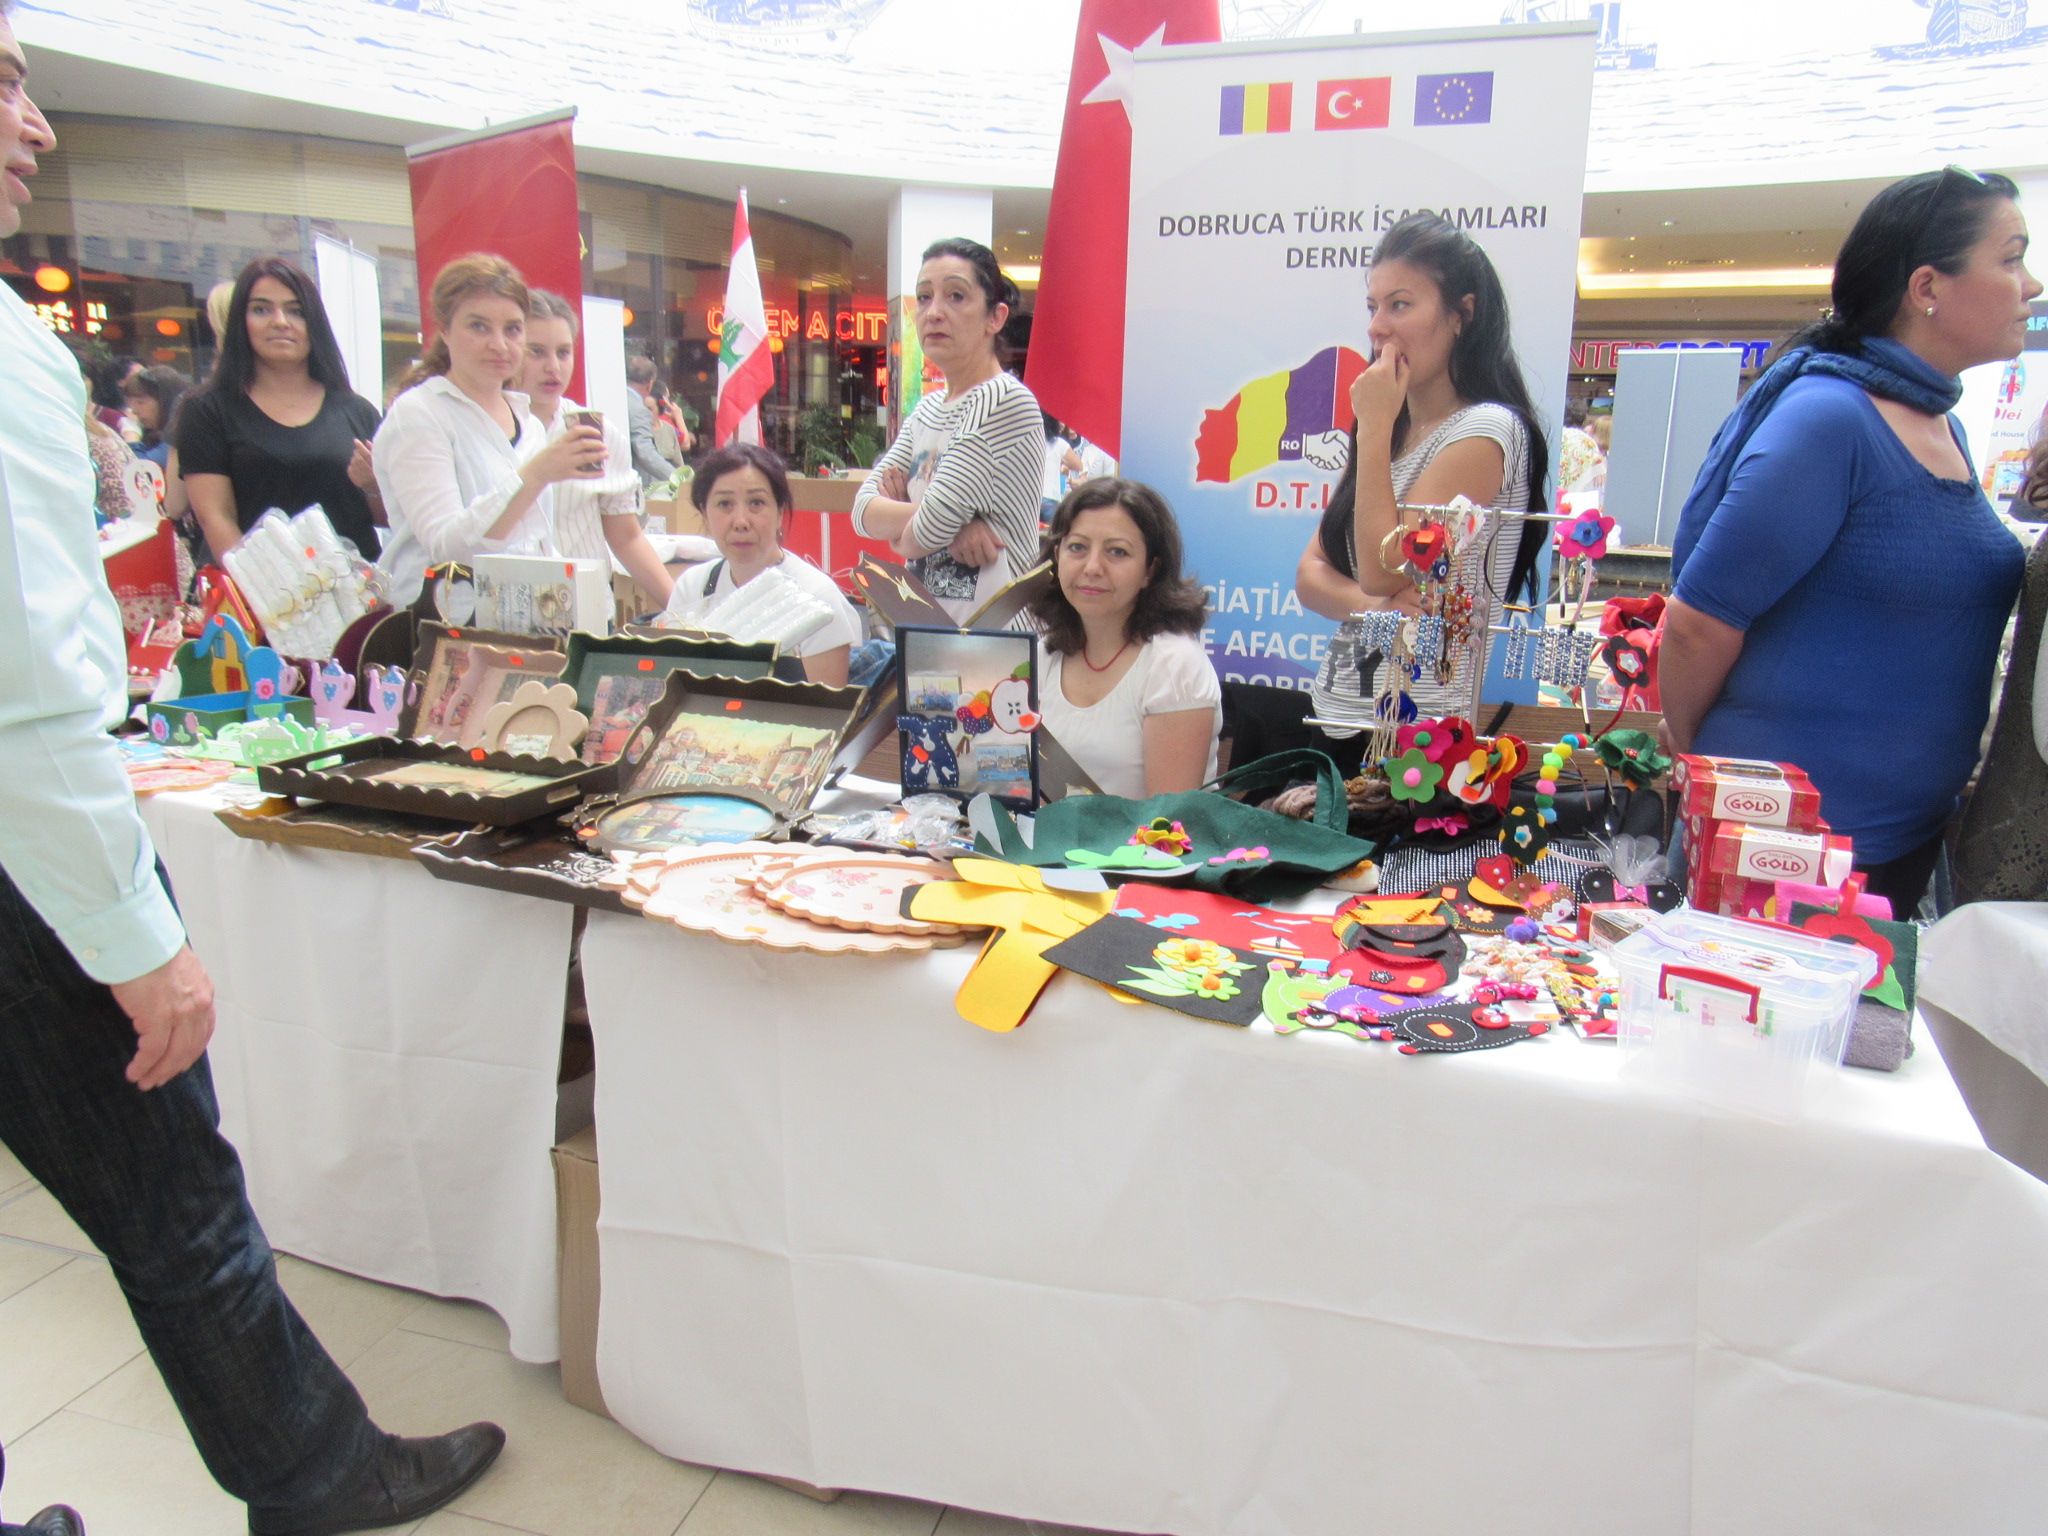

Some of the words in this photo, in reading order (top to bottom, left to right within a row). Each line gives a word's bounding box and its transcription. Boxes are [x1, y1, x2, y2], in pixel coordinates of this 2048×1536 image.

[1159, 213, 1285, 237] DOBRUCA
[1294, 206, 1364, 234] TÜRK
[1373, 205, 1547, 232] İSAMLARI
[1286, 246, 1373, 269] DERNE
[836, 310, 888, 341] CIT
[1281, 440, 1300, 451] RO
[1224, 630, 1328, 661] AFACE
[1730, 798, 1773, 813] GOLD
[1756, 857, 1802, 873] GOLD
